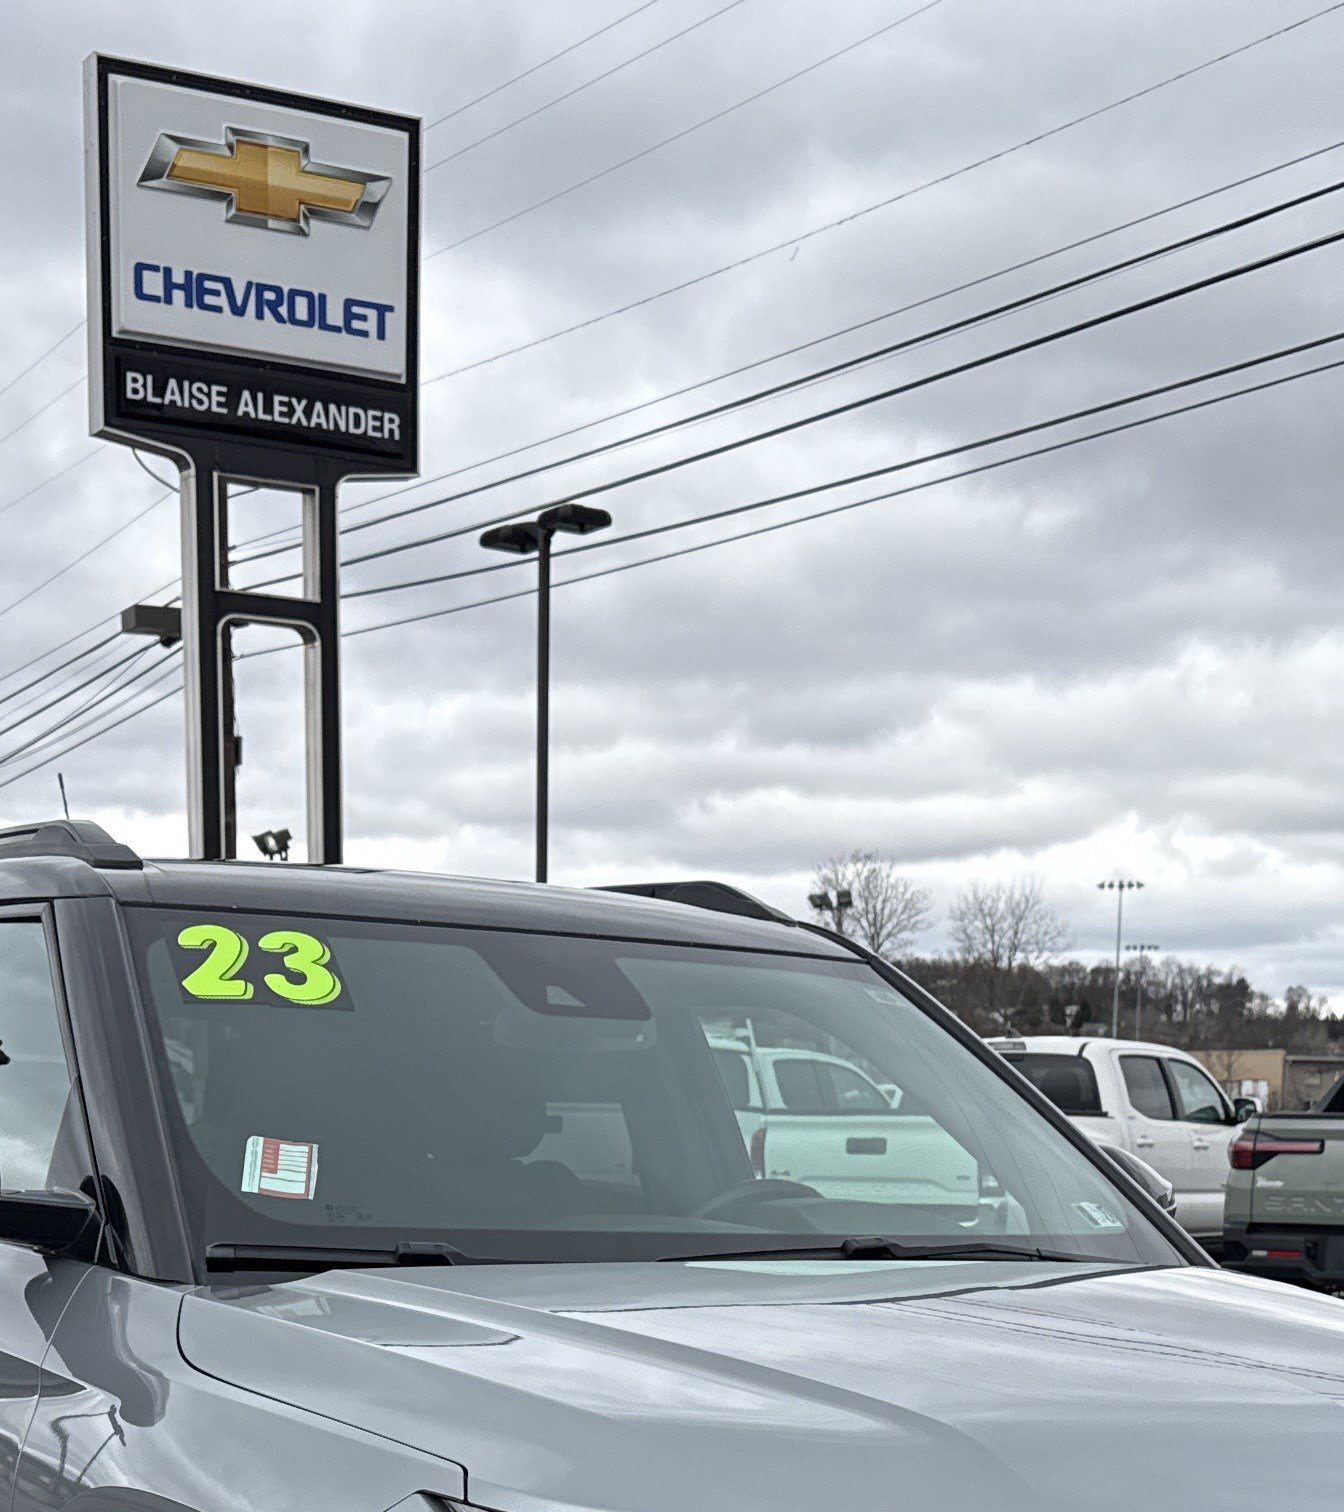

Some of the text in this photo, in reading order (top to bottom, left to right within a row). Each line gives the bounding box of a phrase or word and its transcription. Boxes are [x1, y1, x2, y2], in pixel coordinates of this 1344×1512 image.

[132, 261, 395, 341] CHEVROLET
[124, 370, 401, 442] BLAISE ALEXANDER
[177, 924, 342, 1006] 23
